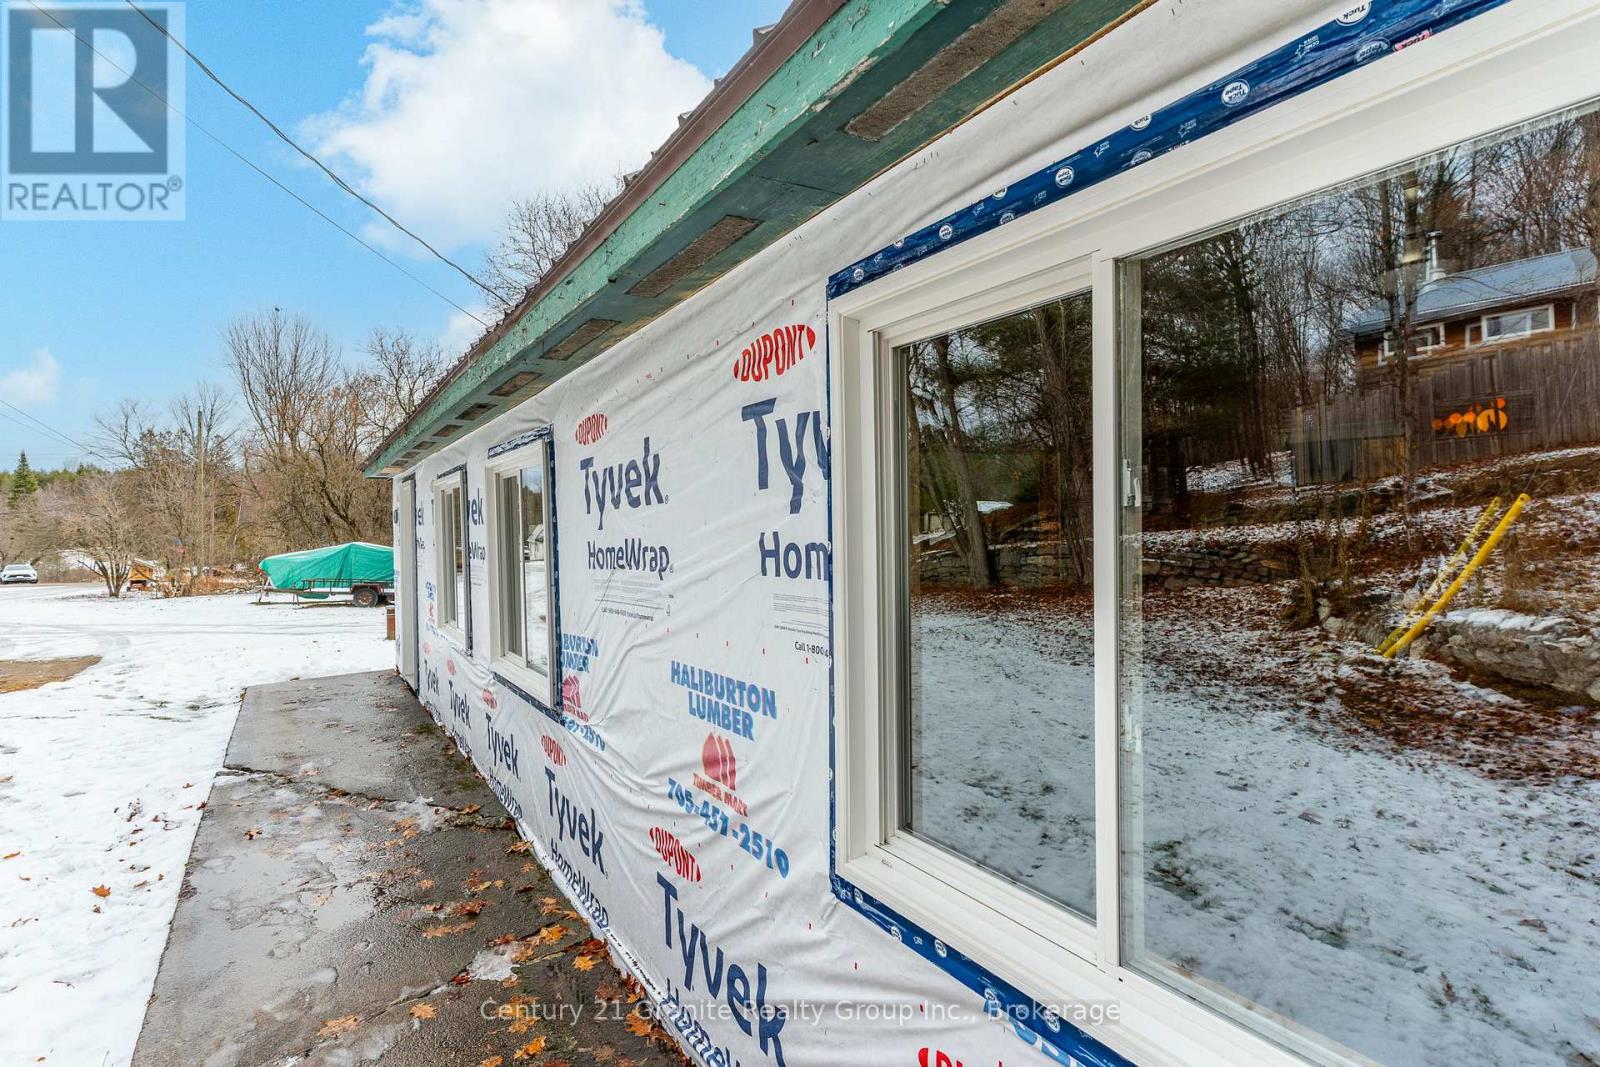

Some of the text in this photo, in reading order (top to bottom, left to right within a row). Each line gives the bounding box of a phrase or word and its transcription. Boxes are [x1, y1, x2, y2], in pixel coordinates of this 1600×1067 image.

[1342, 3, 1367, 20] Tuck
[740, 324, 806, 382] DUPONT
[577, 413, 605, 446] DUPONT
[579, 436, 665, 531] Tyvek
[587, 537, 670, 581] HomeWrap
[671, 659, 778, 720] HALIBURTON
[688, 690, 755, 742] LUMBER
[485, 711, 519, 780] Tyvek
[544, 765, 605, 876] Tyvek
[654, 827, 697, 883] DUPONT
[656, 870, 787, 1067] Tyvek
